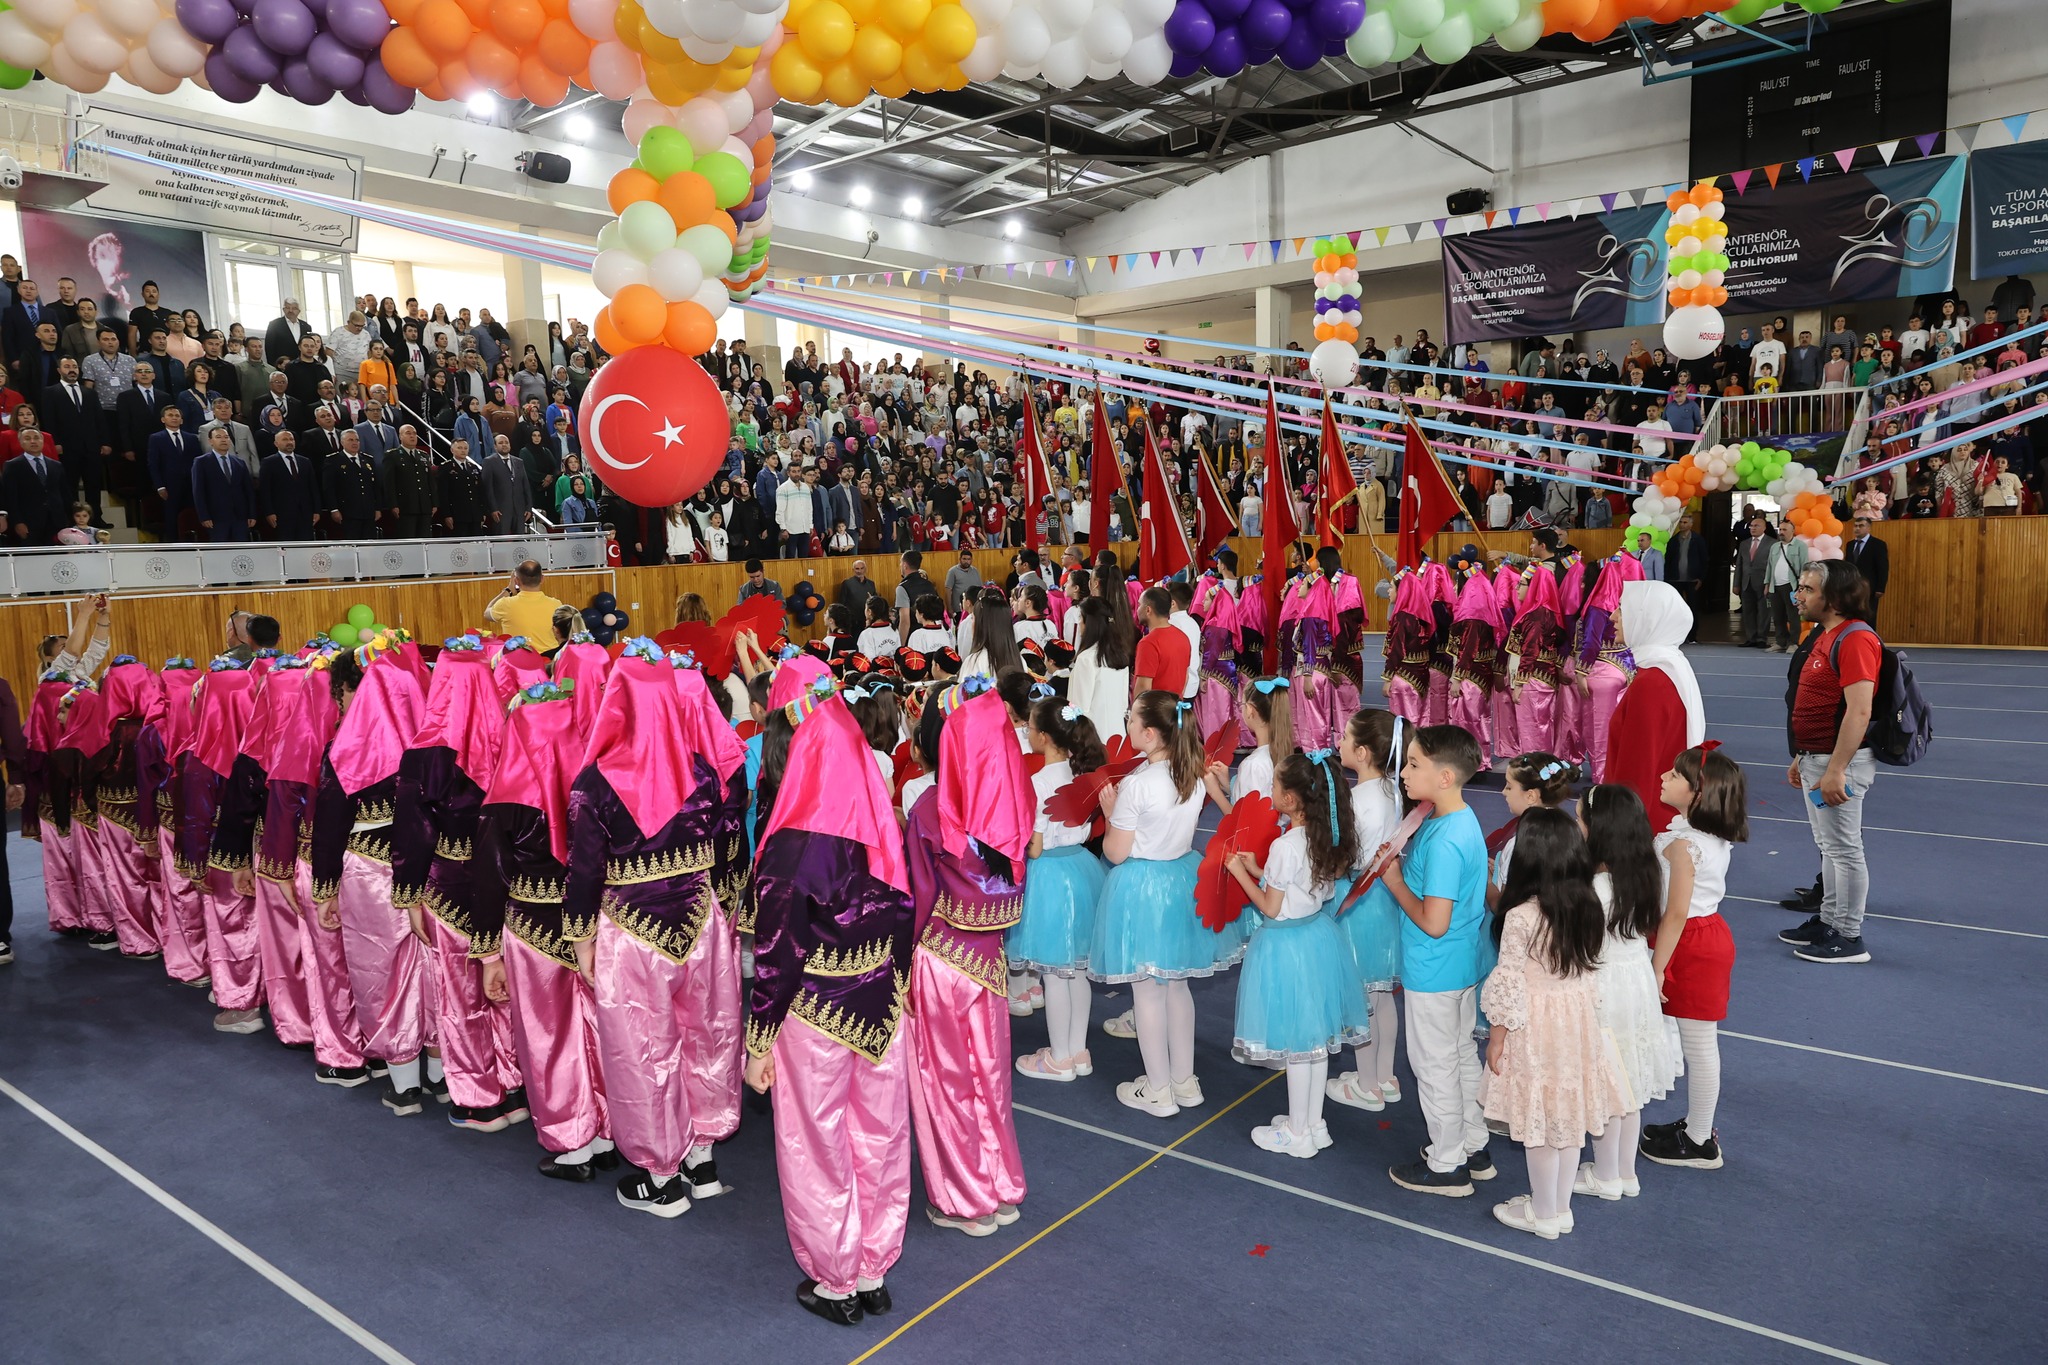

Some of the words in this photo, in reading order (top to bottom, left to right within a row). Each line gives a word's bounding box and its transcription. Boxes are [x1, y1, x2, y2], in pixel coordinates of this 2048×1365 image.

[1806, 59, 1820, 68] TIME
[1839, 59, 1870, 75] FAUL/SET
[1760, 76, 1790, 91] FAUL/SET
[1801, 127, 1820, 136] PEROD
[105, 129, 155, 146] Muvaffak
[156, 140, 189, 153] olmak
[190, 146, 208, 156] için
[210, 149, 226, 158] her
[227, 154, 251, 164] türlü
[252, 159, 305, 175] yardımdan
[306, 170, 335, 181] ziyade
[148, 150, 179, 163] bütün
[180, 157, 219, 171] milletçe
[220, 165, 253, 177] sporun
[254, 172, 297, 186] mahiyeti,
[1795, 159, 1824, 173] SRE
[155, 179, 174, 188] ona
[176, 180, 214, 195] kalbten
[215, 189, 239, 200] sevgi
[240, 193, 288, 208] göstermek,
[2006, 189, 2035, 202] TÜM
[138, 189, 158, 197] onu
[194, 198, 222, 209] vazife
[224, 202, 261, 215] saymak
[1990, 205, 2006, 215] VE
[1725, 229, 1787, 247] ANTRENÖR
[1741, 253, 1798, 268] DİLİYORUM
[1998, 249, 2020, 257] TOKAT
[1460, 271, 1482, 281] TÜM
[1483, 264, 1536, 279] ANTRENÖR
[1450, 283, 1462, 293] VE
[1463, 273, 1547, 292] SPORCULARIMIZA
[1724, 282, 1744, 290] Kemal
[1745, 277, 1787, 287] YAZICIOĞLU
[1452, 292, 1497, 304] BAŞARILAR
[1498, 286, 1545, 298] DİLİYORUM
[1472, 312, 1491, 320] Numan
[1492, 308, 1525, 318] HATİPOĞLU
